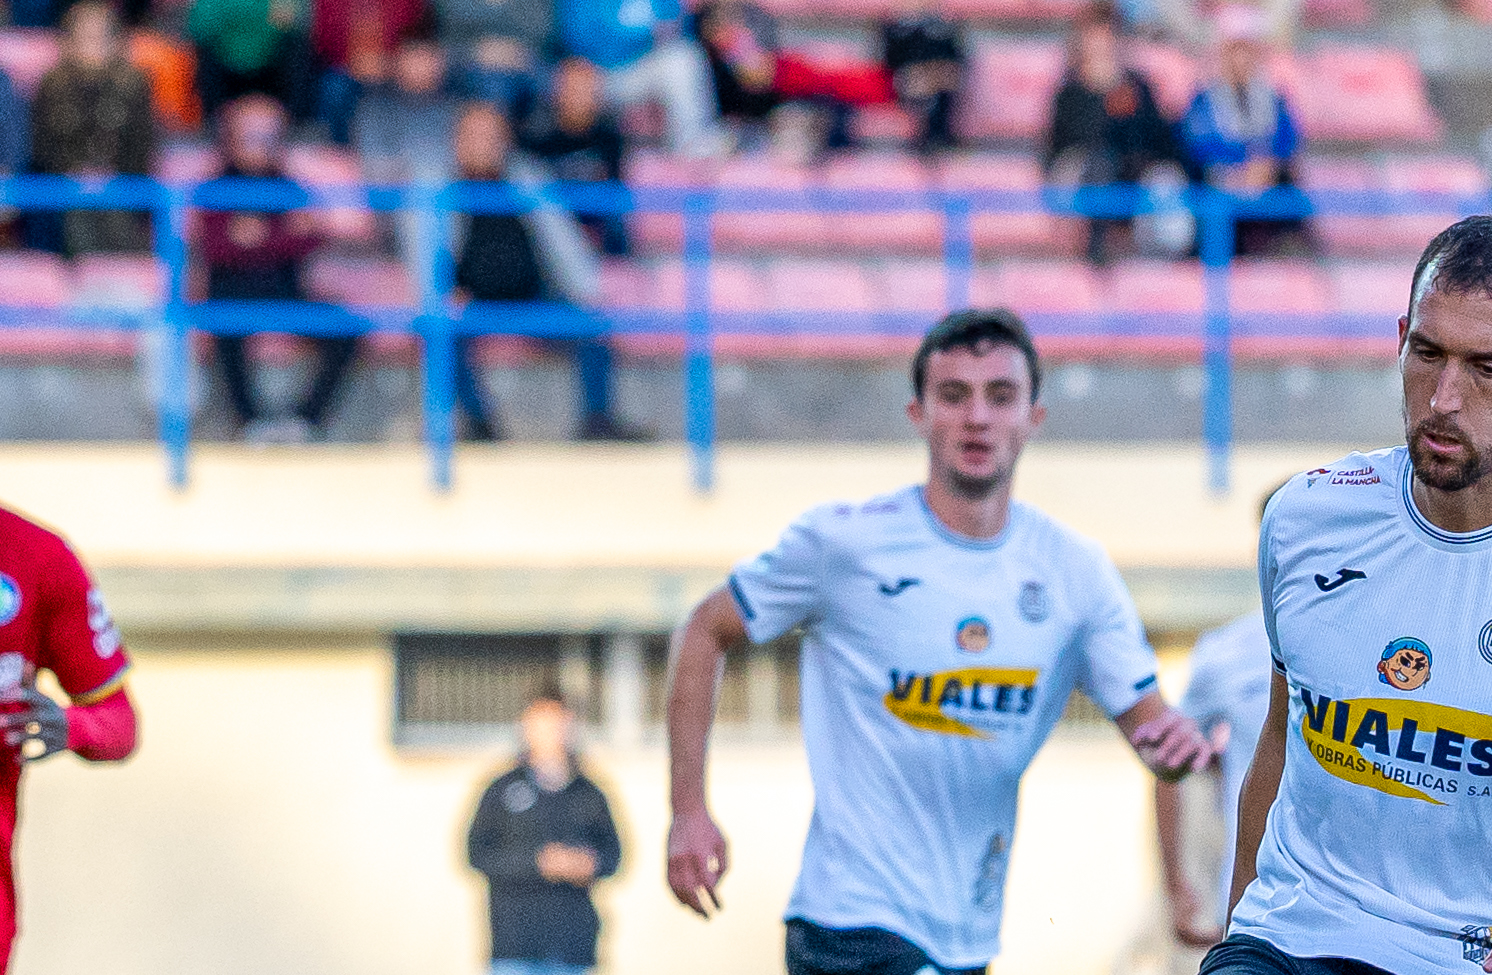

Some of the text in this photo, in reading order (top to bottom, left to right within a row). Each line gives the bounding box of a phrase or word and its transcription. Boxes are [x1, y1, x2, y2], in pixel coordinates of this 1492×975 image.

[1332, 477, 1343, 485] LA
[1316, 743, 1366, 773] OBRAS
[1372, 760, 1459, 794] PÚBLICAS
